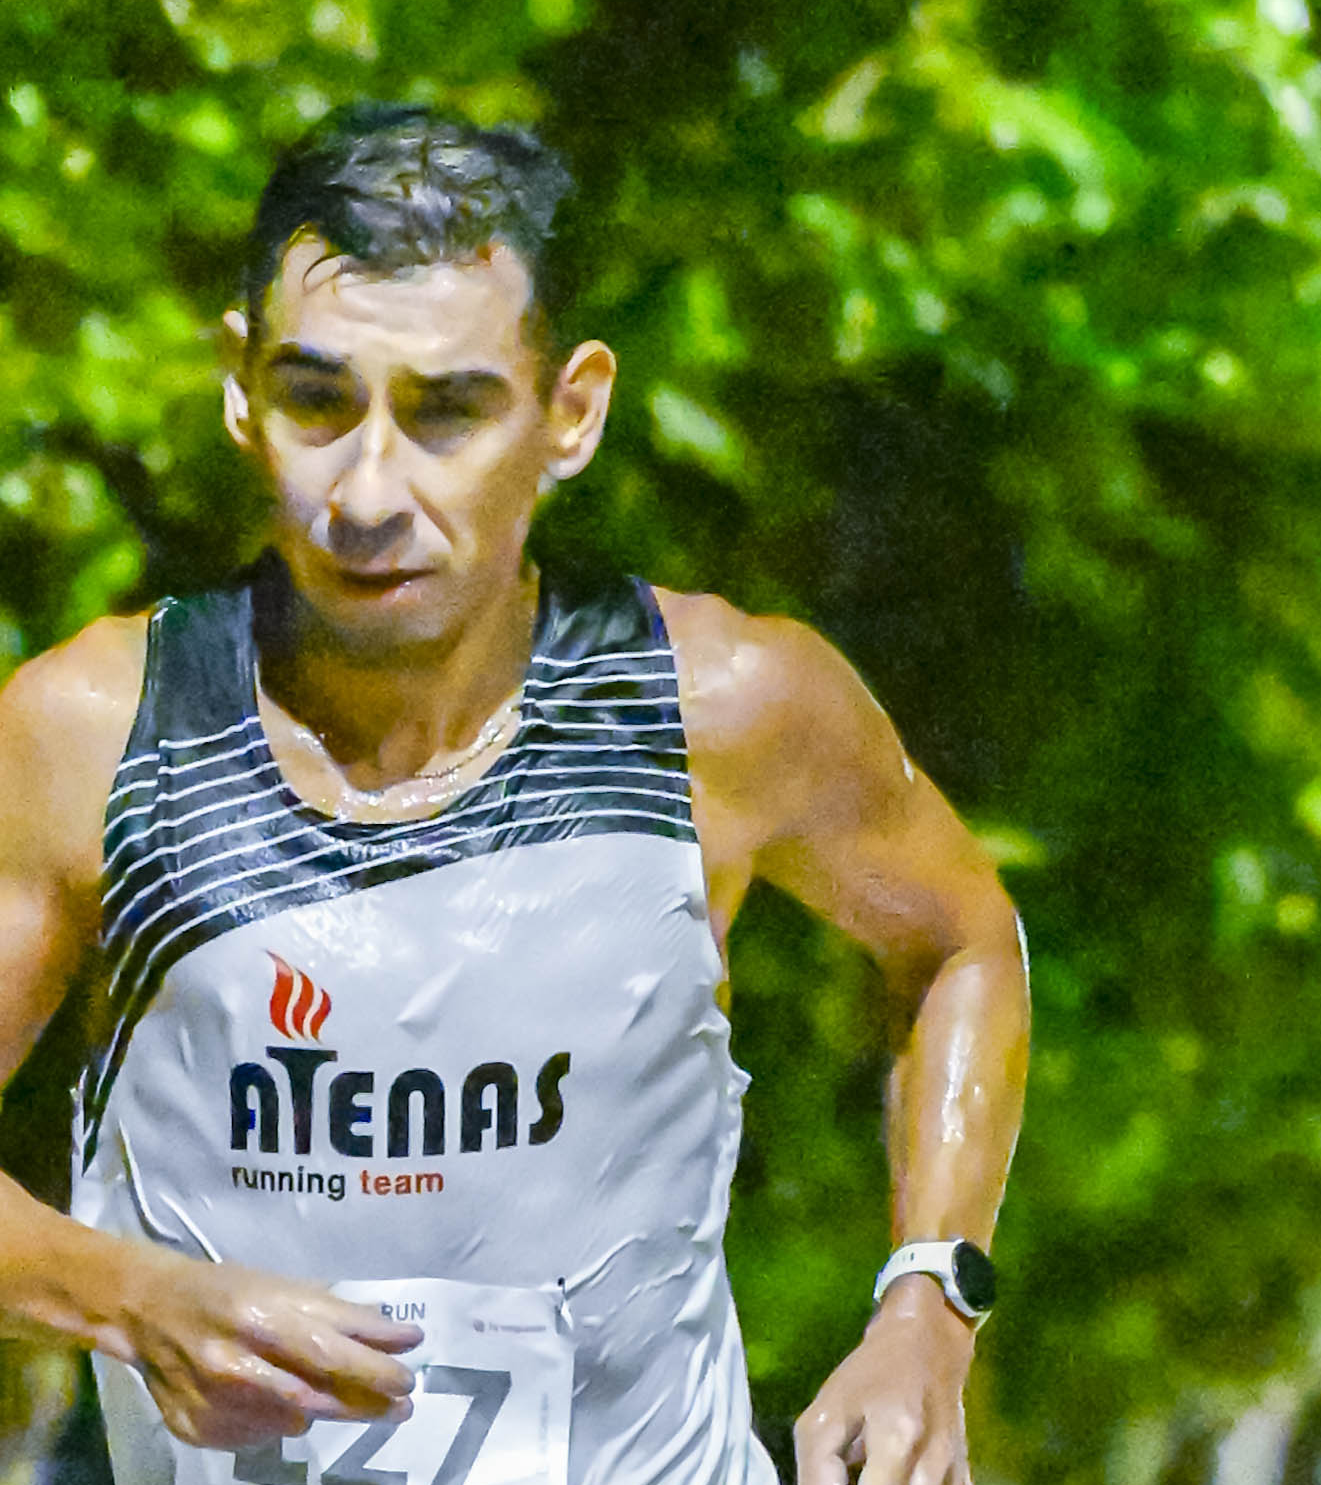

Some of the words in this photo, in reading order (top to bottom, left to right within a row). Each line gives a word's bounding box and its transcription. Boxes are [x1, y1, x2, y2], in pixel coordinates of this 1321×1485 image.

[229, 1045, 572, 1159] ATENAS
[232, 1164, 347, 1201] running
[359, 1168, 445, 1196] team
[381, 1302, 426, 1322] RUN
